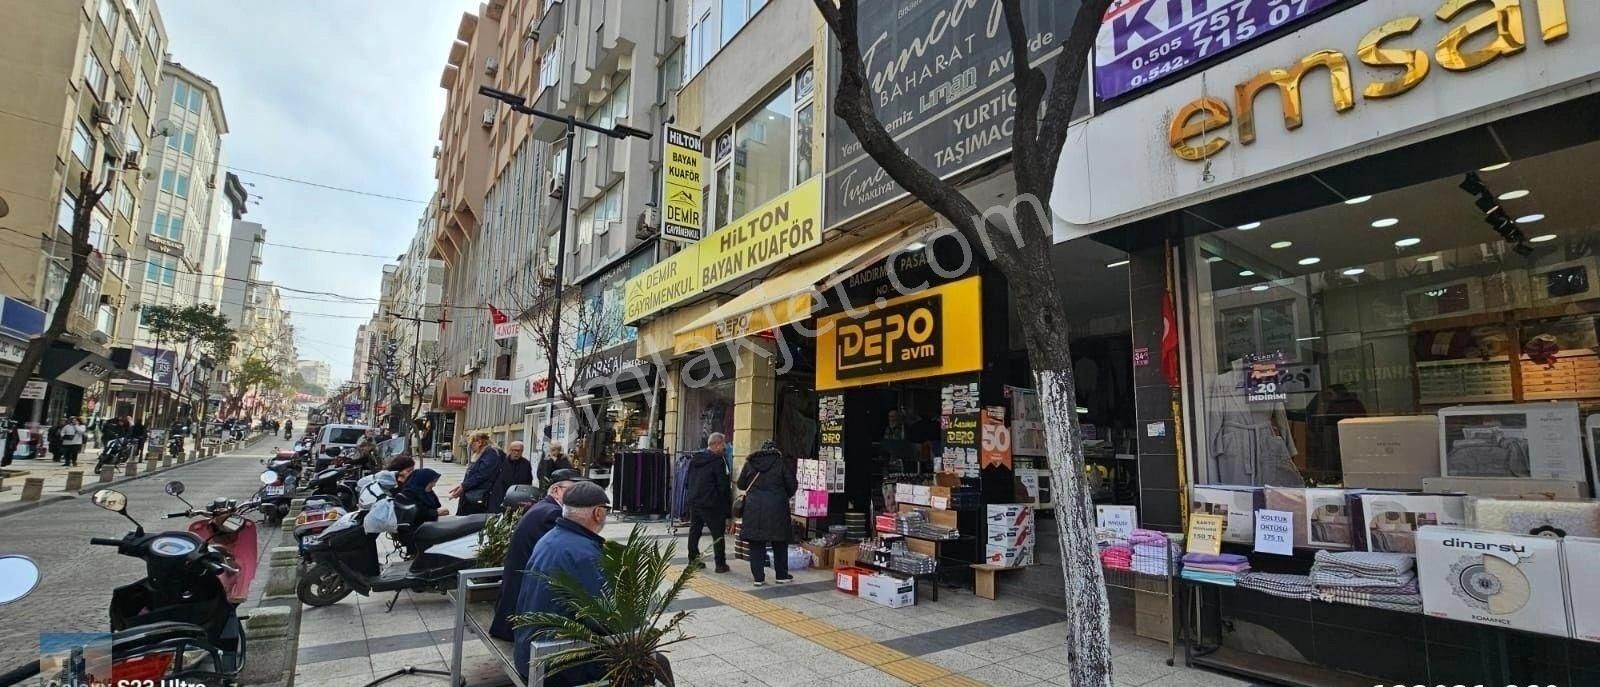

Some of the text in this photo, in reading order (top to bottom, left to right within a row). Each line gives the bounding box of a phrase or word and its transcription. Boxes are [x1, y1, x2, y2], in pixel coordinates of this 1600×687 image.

[1188, 2, 1251, 41] 757
[1193, 18, 1257, 58] 715
[880, 33, 976, 108] BAHARAT
[672, 151, 697, 168] BAYAN
[669, 165, 700, 183] KUAFÖR
[858, 180, 896, 205] NAKLİYAT
[667, 204, 700, 226] DEMİR
[666, 224, 700, 240] GAYRİMENKUL
[702, 217, 814, 288] BAYAN KUAFÖR
[646, 260, 678, 290] DEMİR
[628, 276, 695, 318] GAYRİMENKUL
[838, 307, 934, 364] DEPO
[901, 343, 935, 360] avm
[479, 385, 509, 395] BOSCH
[981, 423, 1011, 452] 50
[1260, 514, 1288, 523] KOLTUK
[1442, 538, 1525, 553] dinarsu
[1471, 614, 1512, 625] ROMANCE
